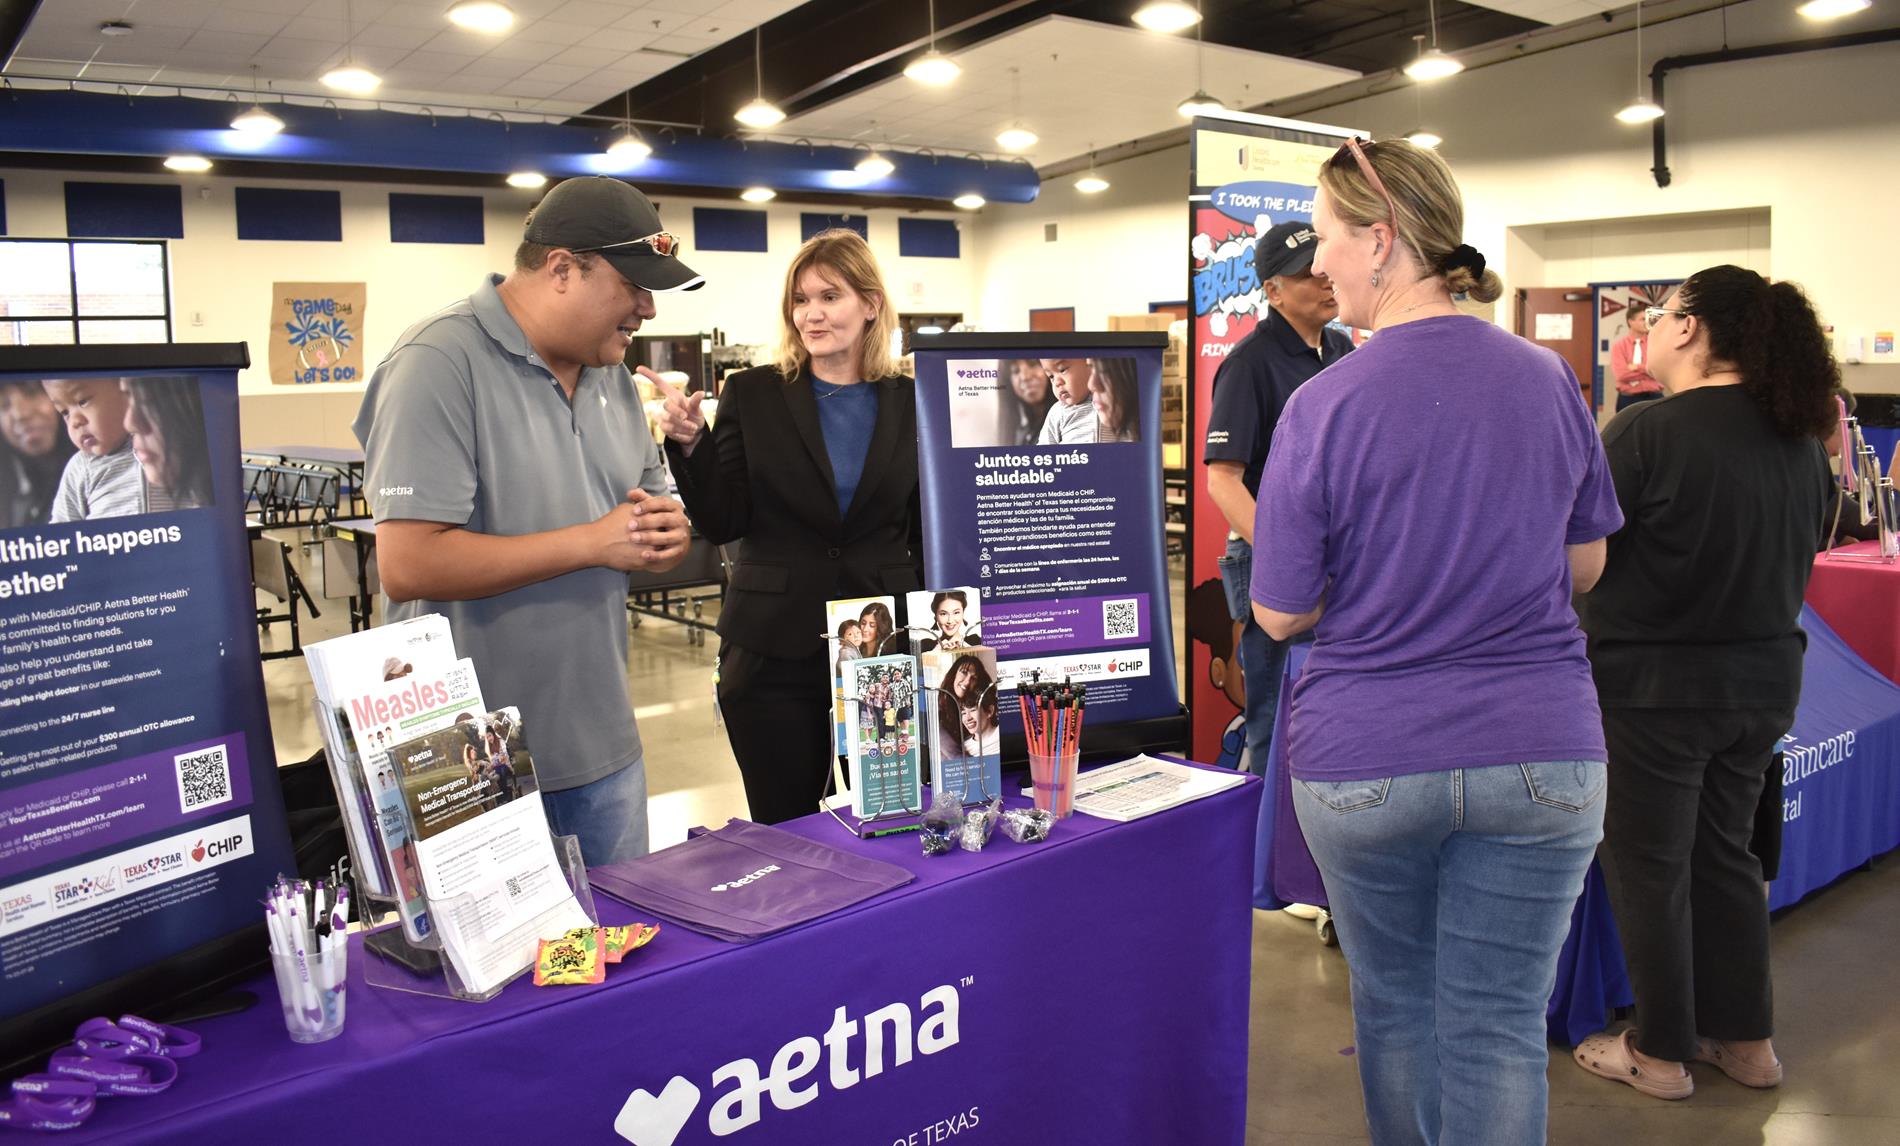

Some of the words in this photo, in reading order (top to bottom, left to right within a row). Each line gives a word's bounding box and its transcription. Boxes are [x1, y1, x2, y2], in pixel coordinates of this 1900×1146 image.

[1216, 192, 1227, 206] I
[1229, 193, 1261, 209] TOOK
[1264, 197, 1284, 211] THE
[1193, 245, 1261, 318] BRUS
[966, 368, 998, 378] aetna
[975, 453, 1030, 468] Juntos
[1034, 454, 1052, 466] es
[1056, 450, 1089, 465] más
[385, 486, 414, 496] aetna
[1010, 492, 1035, 500] ayudarte
[1081, 496, 1116, 504] compromiso
[983, 535, 1015, 544] aprovechar
[1016, 533, 1048, 542] grandiosos
[1004, 526, 1030, 534] podemos
[1059, 523, 1076, 531] ayuda
[0, 535, 70, 563] lthier
[76, 526, 182, 555] happens
[10, 613, 30, 624] with
[32, 602, 102, 621] Medicaid/CHIP.
[105, 599, 130, 609] Aetna
[132, 594, 157, 605] Better
[9, 622, 60, 639] committed
[62, 621, 72, 630] to
[73, 616, 104, 628] finding
[106, 610, 144, 623] solutions
[146, 607, 158, 616] for
[160, 605, 176, 616] you
[3, 642, 39, 654] family's
[41, 634, 70, 647] health
[72, 633, 92, 642] care
[95, 627, 124, 638] needs.
[21, 659, 42, 669] help
[44, 656, 61, 667] you
[63, 644, 115, 662] understand
[116, 641, 133, 652] and
[134, 638, 153, 649] take
[16, 675, 26, 685] of
[28, 670, 52, 685] great
[54, 663, 91, 678] benefits
[1118, 660, 1143, 672] CHIP
[21, 694, 34, 703] the
[35, 689, 53, 700] right
[55, 686, 80, 696] doctor
[352, 679, 449, 731] Measles
[39, 720, 47, 728] to
[48, 717, 60, 726] the
[61, 712, 79, 723] 24/7
[80, 709, 101, 719] nurse
[102, 706, 115, 714] line
[28, 751, 40, 760] the
[41, 745, 60, 757] most
[61, 742, 73, 752] out
[74, 740, 82, 749] of
[83, 738, 98, 749] your
[99, 732, 118, 743] $300
[119, 726, 143, 738] annual
[143, 722, 159, 732] OTC
[160, 715, 195, 729] allowance
[12, 762, 35, 775] select
[36, 750, 85, 769] health-related
[86, 743, 117, 758] products
[414, 749, 433, 763] aetna
[129, 773, 147, 784] 2-1-1
[418, 776, 468, 802] Non-Emergency
[421, 797, 447, 814] Medical
[446, 780, 491, 803] Transportation
[207, 834, 243, 858] CHIP
[124, 862, 148, 878] TEXAS
[160, 852, 182, 867] STAR
[726, 864, 781, 888] aetna
[55, 886, 79, 903] STAR
[922, 1106, 980, 1146] TEXAS
